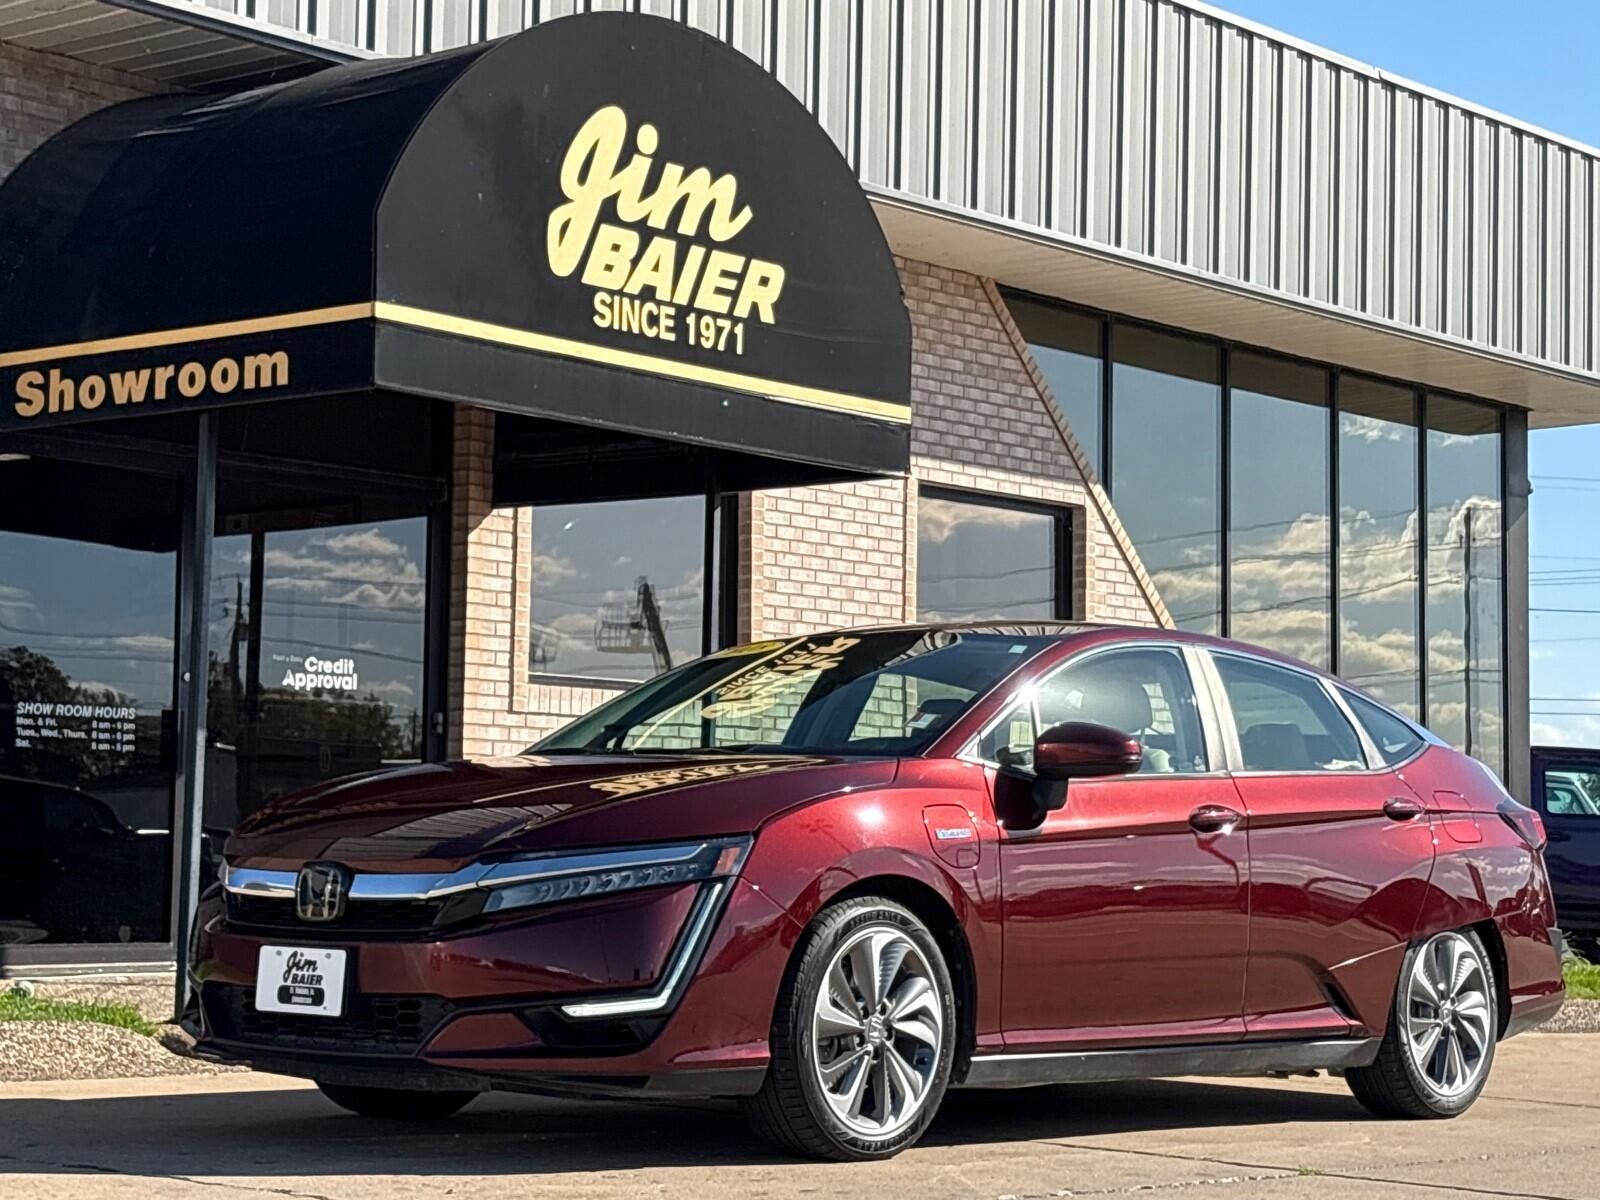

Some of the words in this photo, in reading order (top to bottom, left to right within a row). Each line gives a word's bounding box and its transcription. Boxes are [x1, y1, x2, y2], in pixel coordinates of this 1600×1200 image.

[547, 105, 753, 278] Jim
[581, 223, 786, 325] BAIER
[593, 291, 677, 342] SINCE
[686, 313, 744, 355] 1971
[14, 350, 289, 417] Showroom
[304, 656, 354, 674] Credit
[281, 669, 358, 691] Approval
[16, 701, 53, 715] SHOW
[55, 704, 92, 717] ROOM
[94, 706, 136, 719] HOURS
[16, 716, 35, 726] Mon.
[45, 717, 58, 727] Fri.
[15, 738, 32, 748] Sat.
[283, 950, 318, 983] Jim
[291, 973, 323, 985] BAIER
